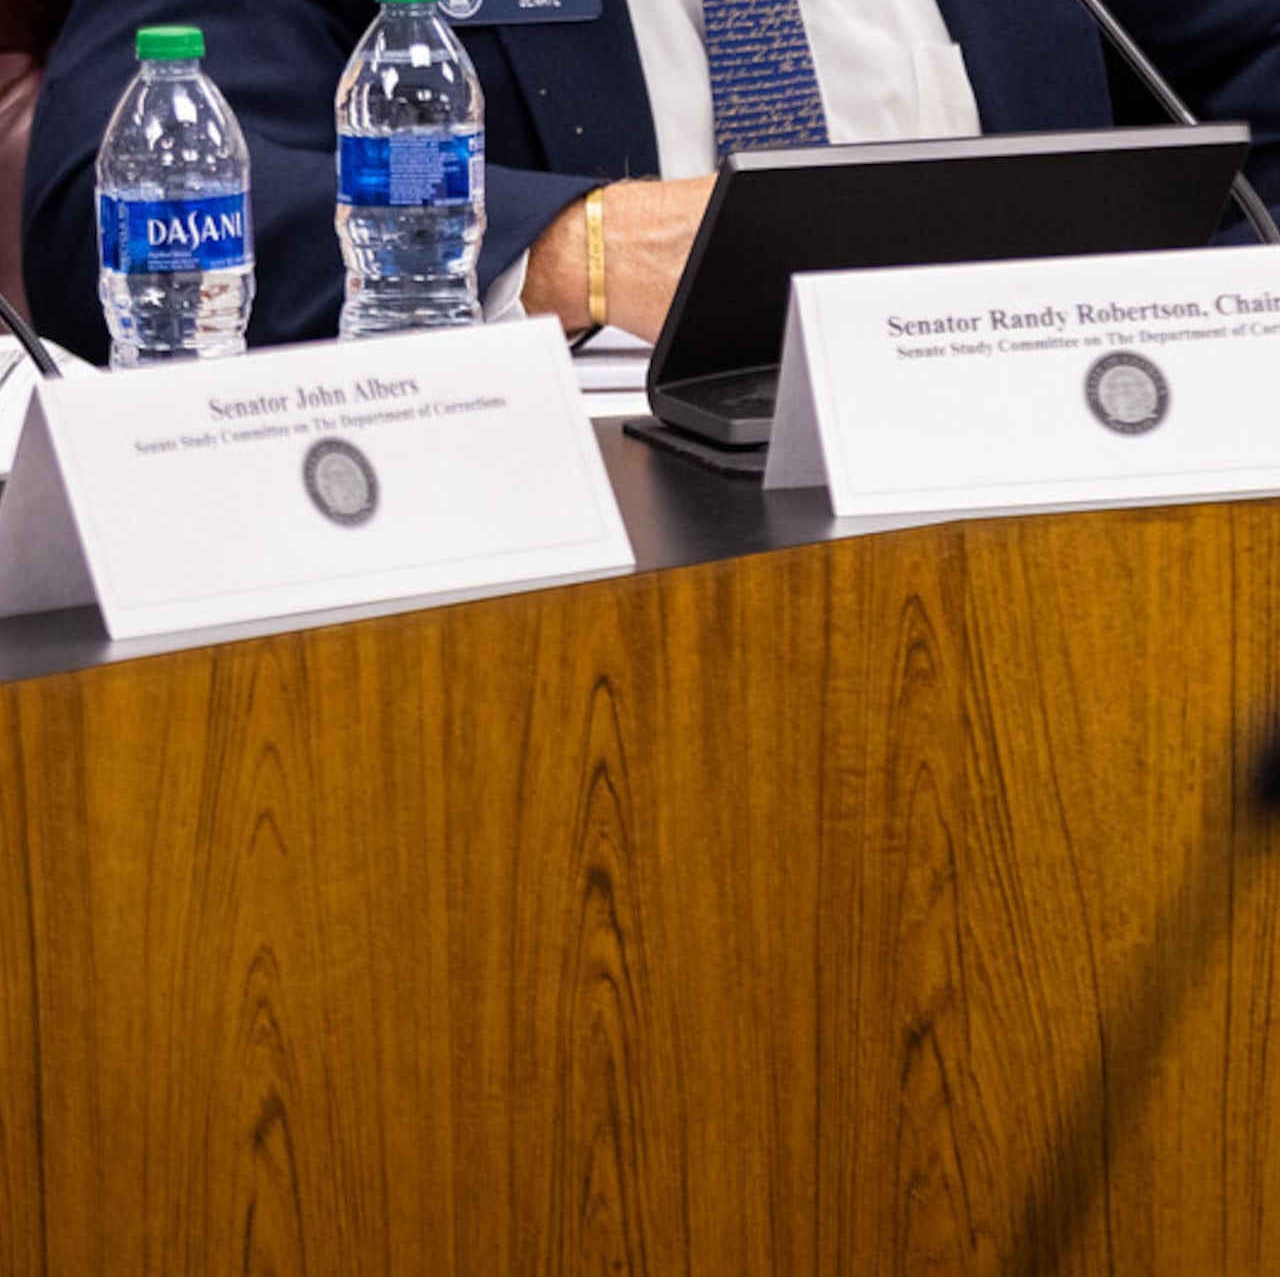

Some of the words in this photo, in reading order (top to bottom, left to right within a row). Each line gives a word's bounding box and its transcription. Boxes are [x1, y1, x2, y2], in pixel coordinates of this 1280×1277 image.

[147, 210, 243, 251] DASANI
[888, 315, 981, 337] Senator
[990, 306, 1068, 331] Randy
[1077, 301, 1209, 325] Robertson,
[897, 343, 946, 358] Senate
[950, 341, 993, 357] Study
[998, 334, 1079, 353] Committee
[1084, 334, 1102, 346] on
[1107, 331, 1134, 345] The
[1139, 326, 1227, 344] Department
[1232, 324, 1247, 337] of
[208, 395, 289, 421] Senator
[296, 385, 347, 410] John
[354, 377, 420, 403] Albers
[134, 439, 177, 454] Senate
[180, 433, 217, 450] Study
[221, 424, 290, 443] Committee
[293, 423, 310, 434] on
[313, 417, 337, 431] The
[339, 408, 415, 428] Department
[418, 403, 432, 417] of
[433, 396, 506, 415] Corrections
